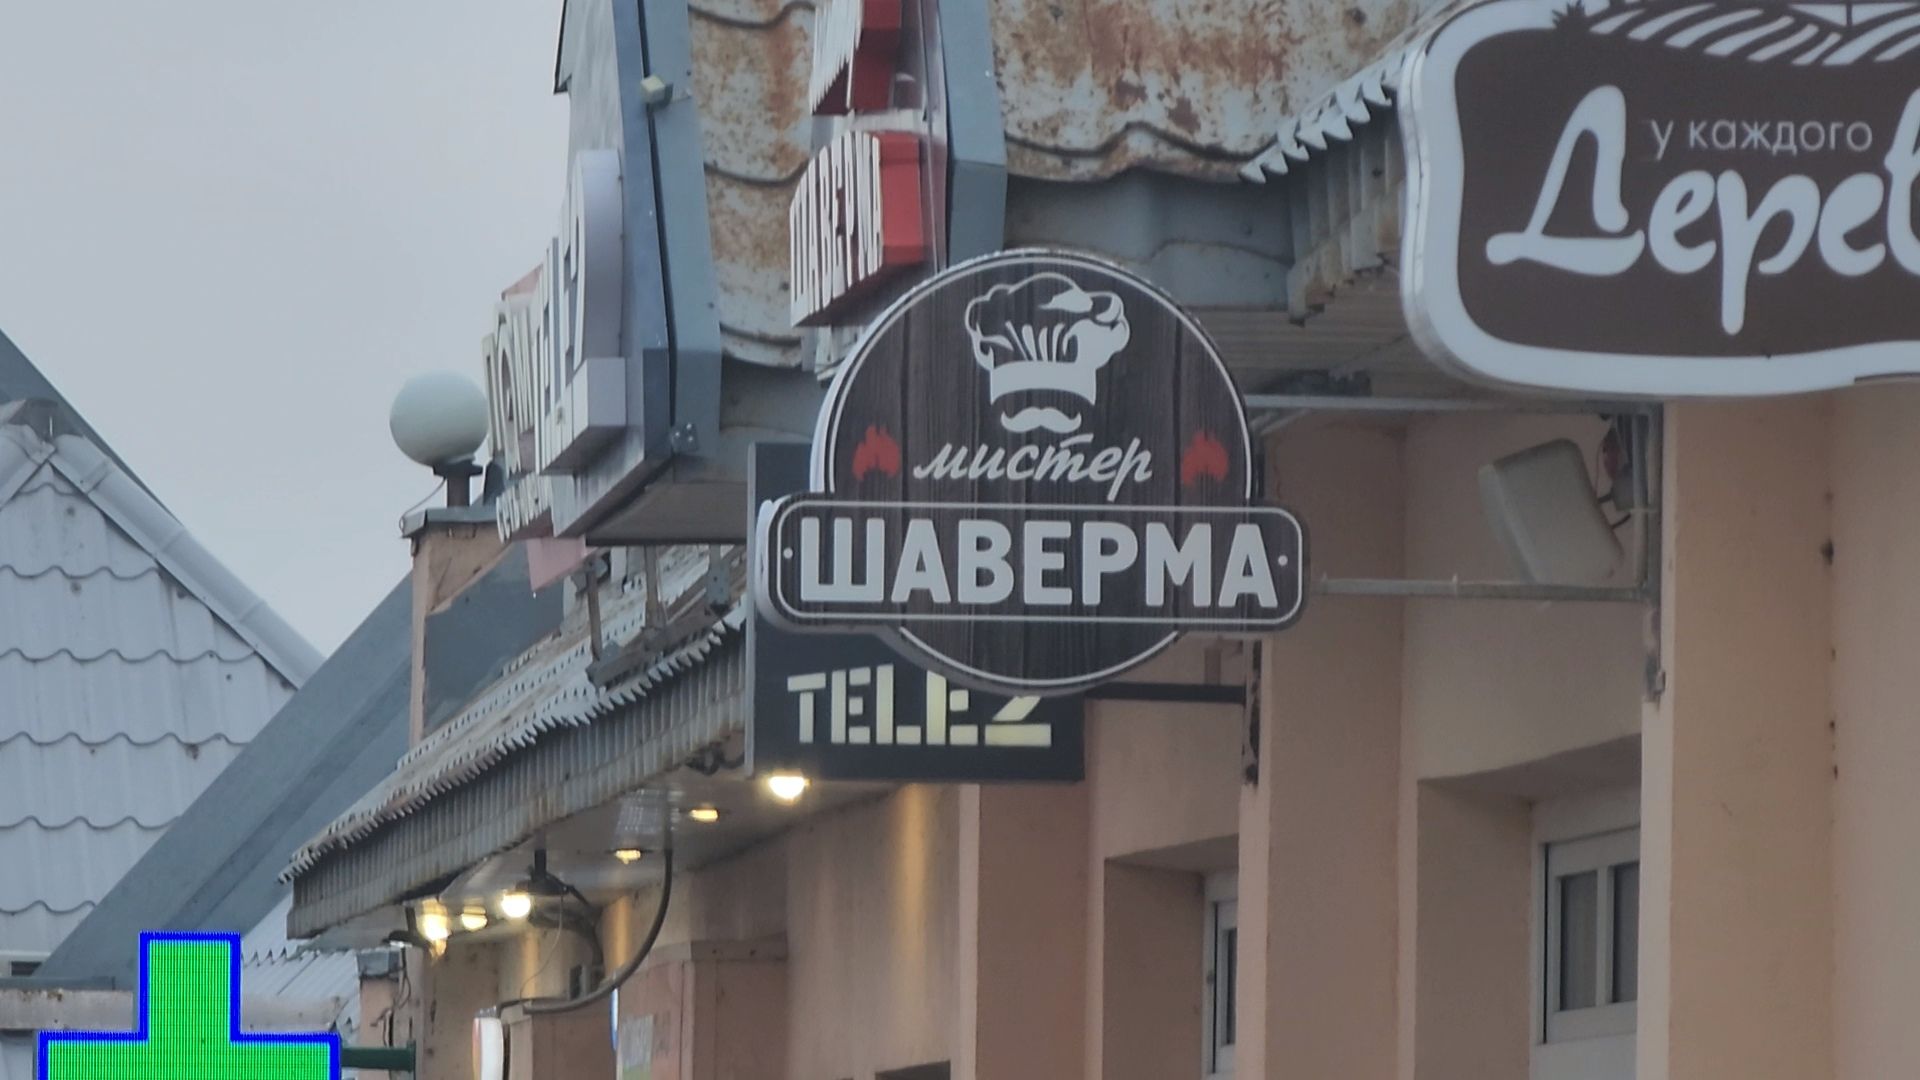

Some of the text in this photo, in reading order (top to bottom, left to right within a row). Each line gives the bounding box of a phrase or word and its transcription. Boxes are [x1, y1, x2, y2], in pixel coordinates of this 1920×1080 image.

[1650, 119, 1874, 162] у каждого
[789, 131, 883, 327] ШАВЕРМА
[913, 433, 1153, 501] мистер
[800, 516, 1278, 608] ШАВЕРМА
